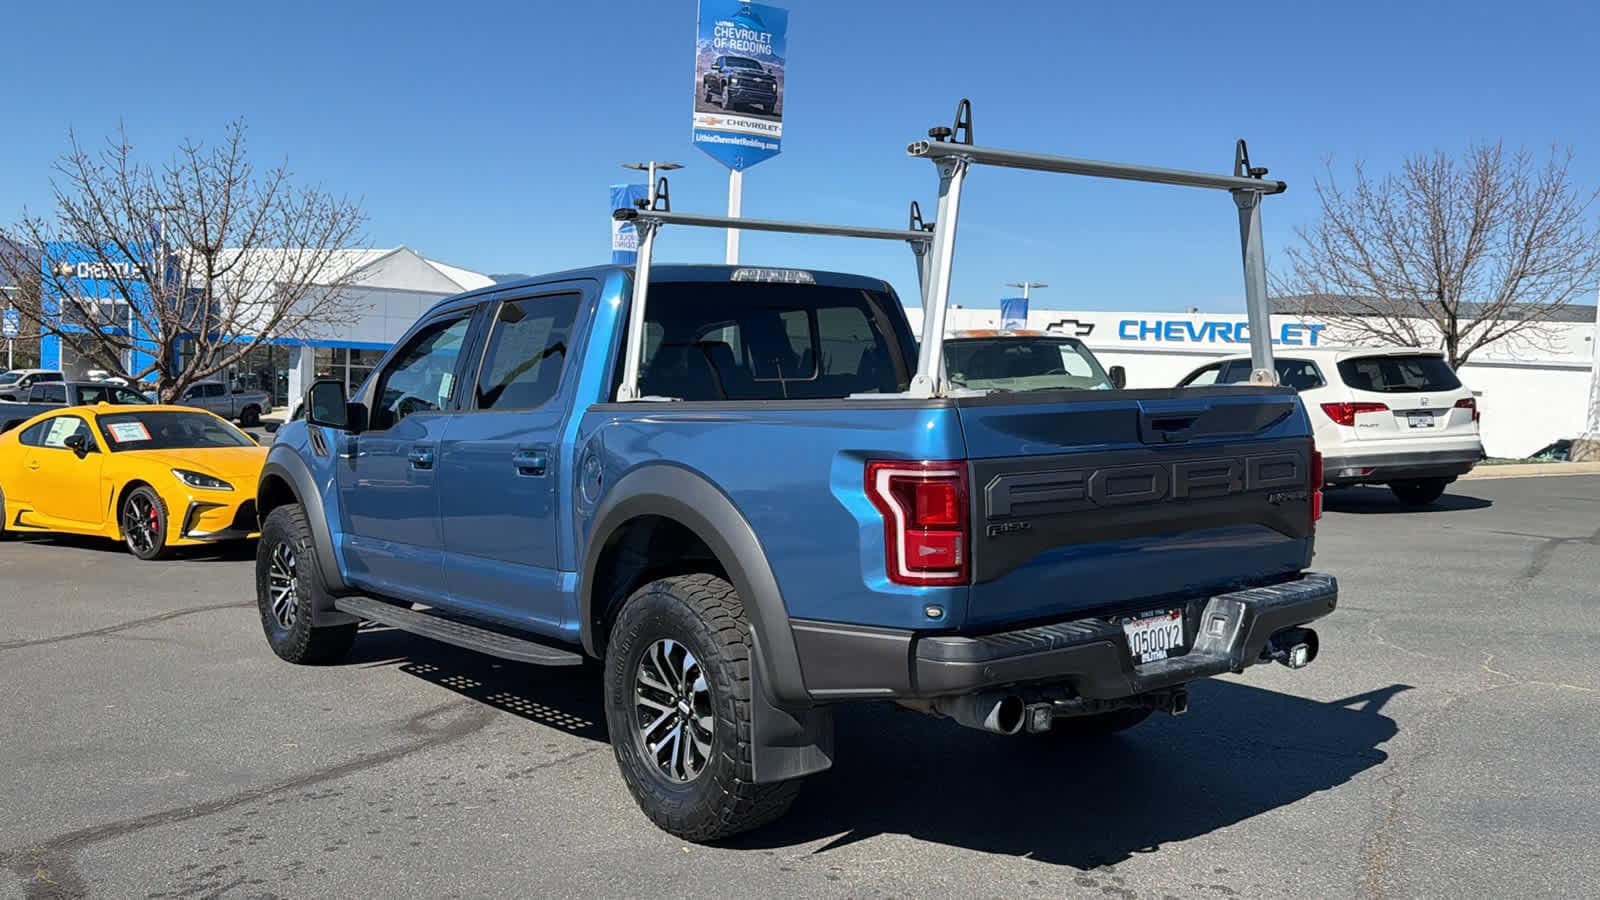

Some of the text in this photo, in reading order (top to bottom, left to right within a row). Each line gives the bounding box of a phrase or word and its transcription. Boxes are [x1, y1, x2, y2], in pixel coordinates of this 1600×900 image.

[714, 26, 773, 44] CHEVROLET
[713, 37, 773, 56] OF REDDING
[726, 118, 779, 132] CHEVROLET
[1118, 319, 1327, 347] CHEVROET
[984, 452, 1300, 520] FORD
